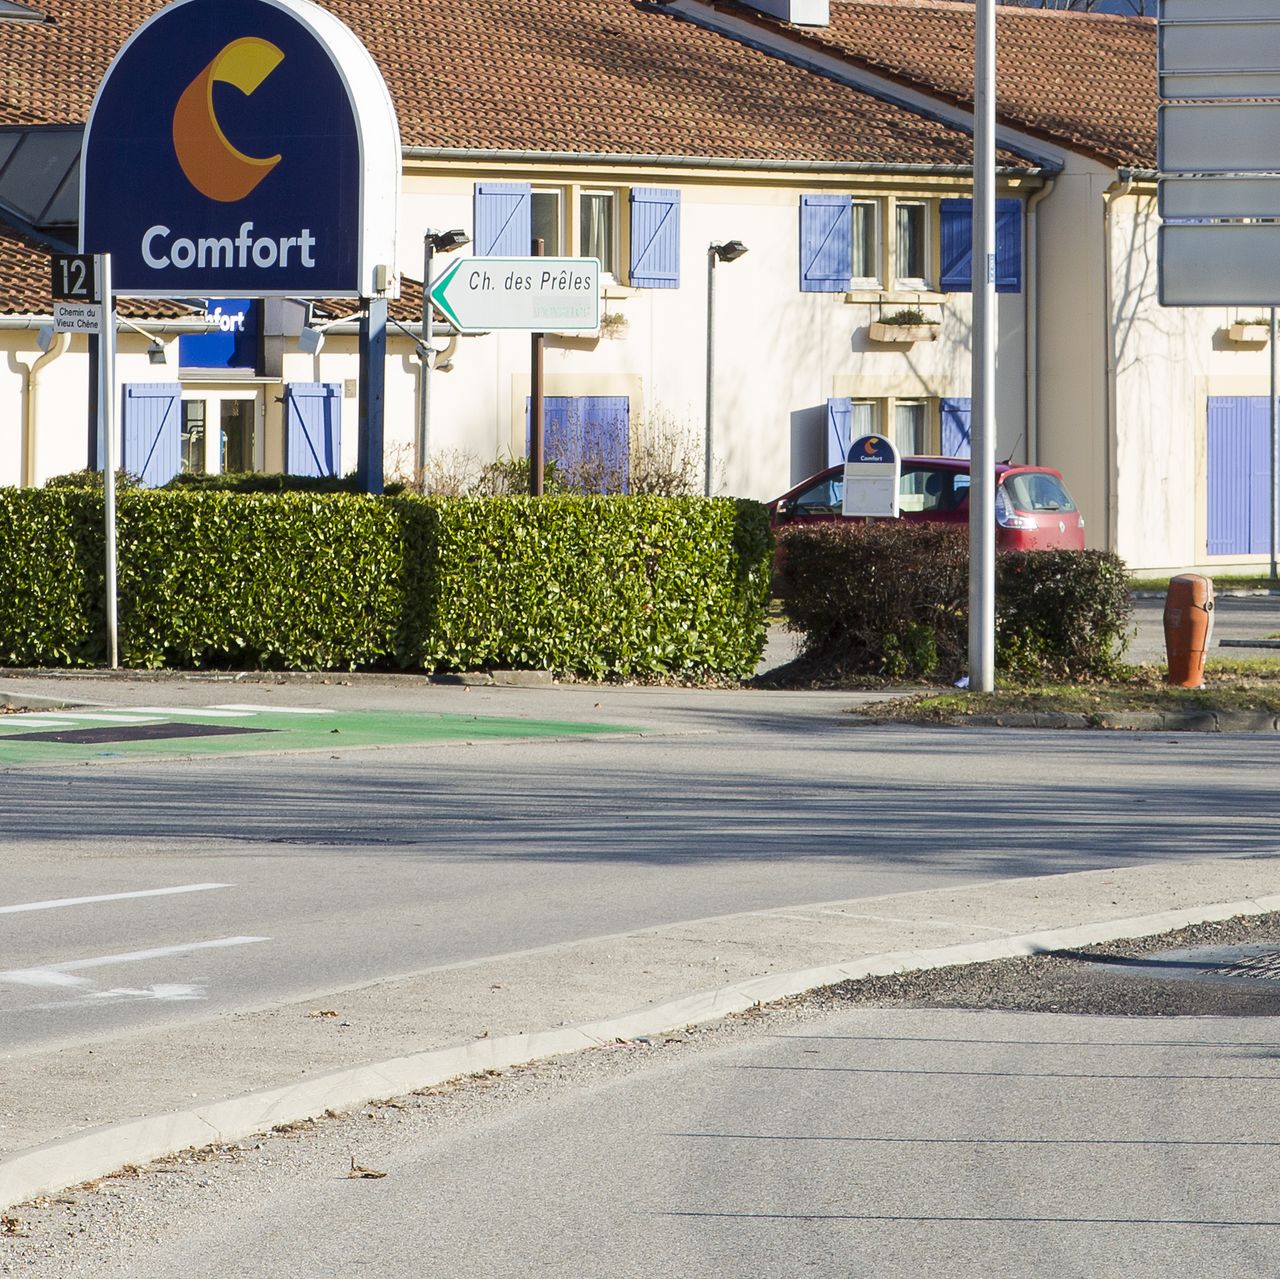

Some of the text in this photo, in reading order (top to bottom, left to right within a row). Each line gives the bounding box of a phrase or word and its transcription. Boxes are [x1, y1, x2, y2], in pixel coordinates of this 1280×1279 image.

[141, 221, 316, 270] Comfort
[59, 259, 87, 295] 12
[469, 270, 592, 291] Ch. des Prêles
[59, 307, 96, 318] Chemin du
[56, 319, 99, 329] Vieux Chêne
